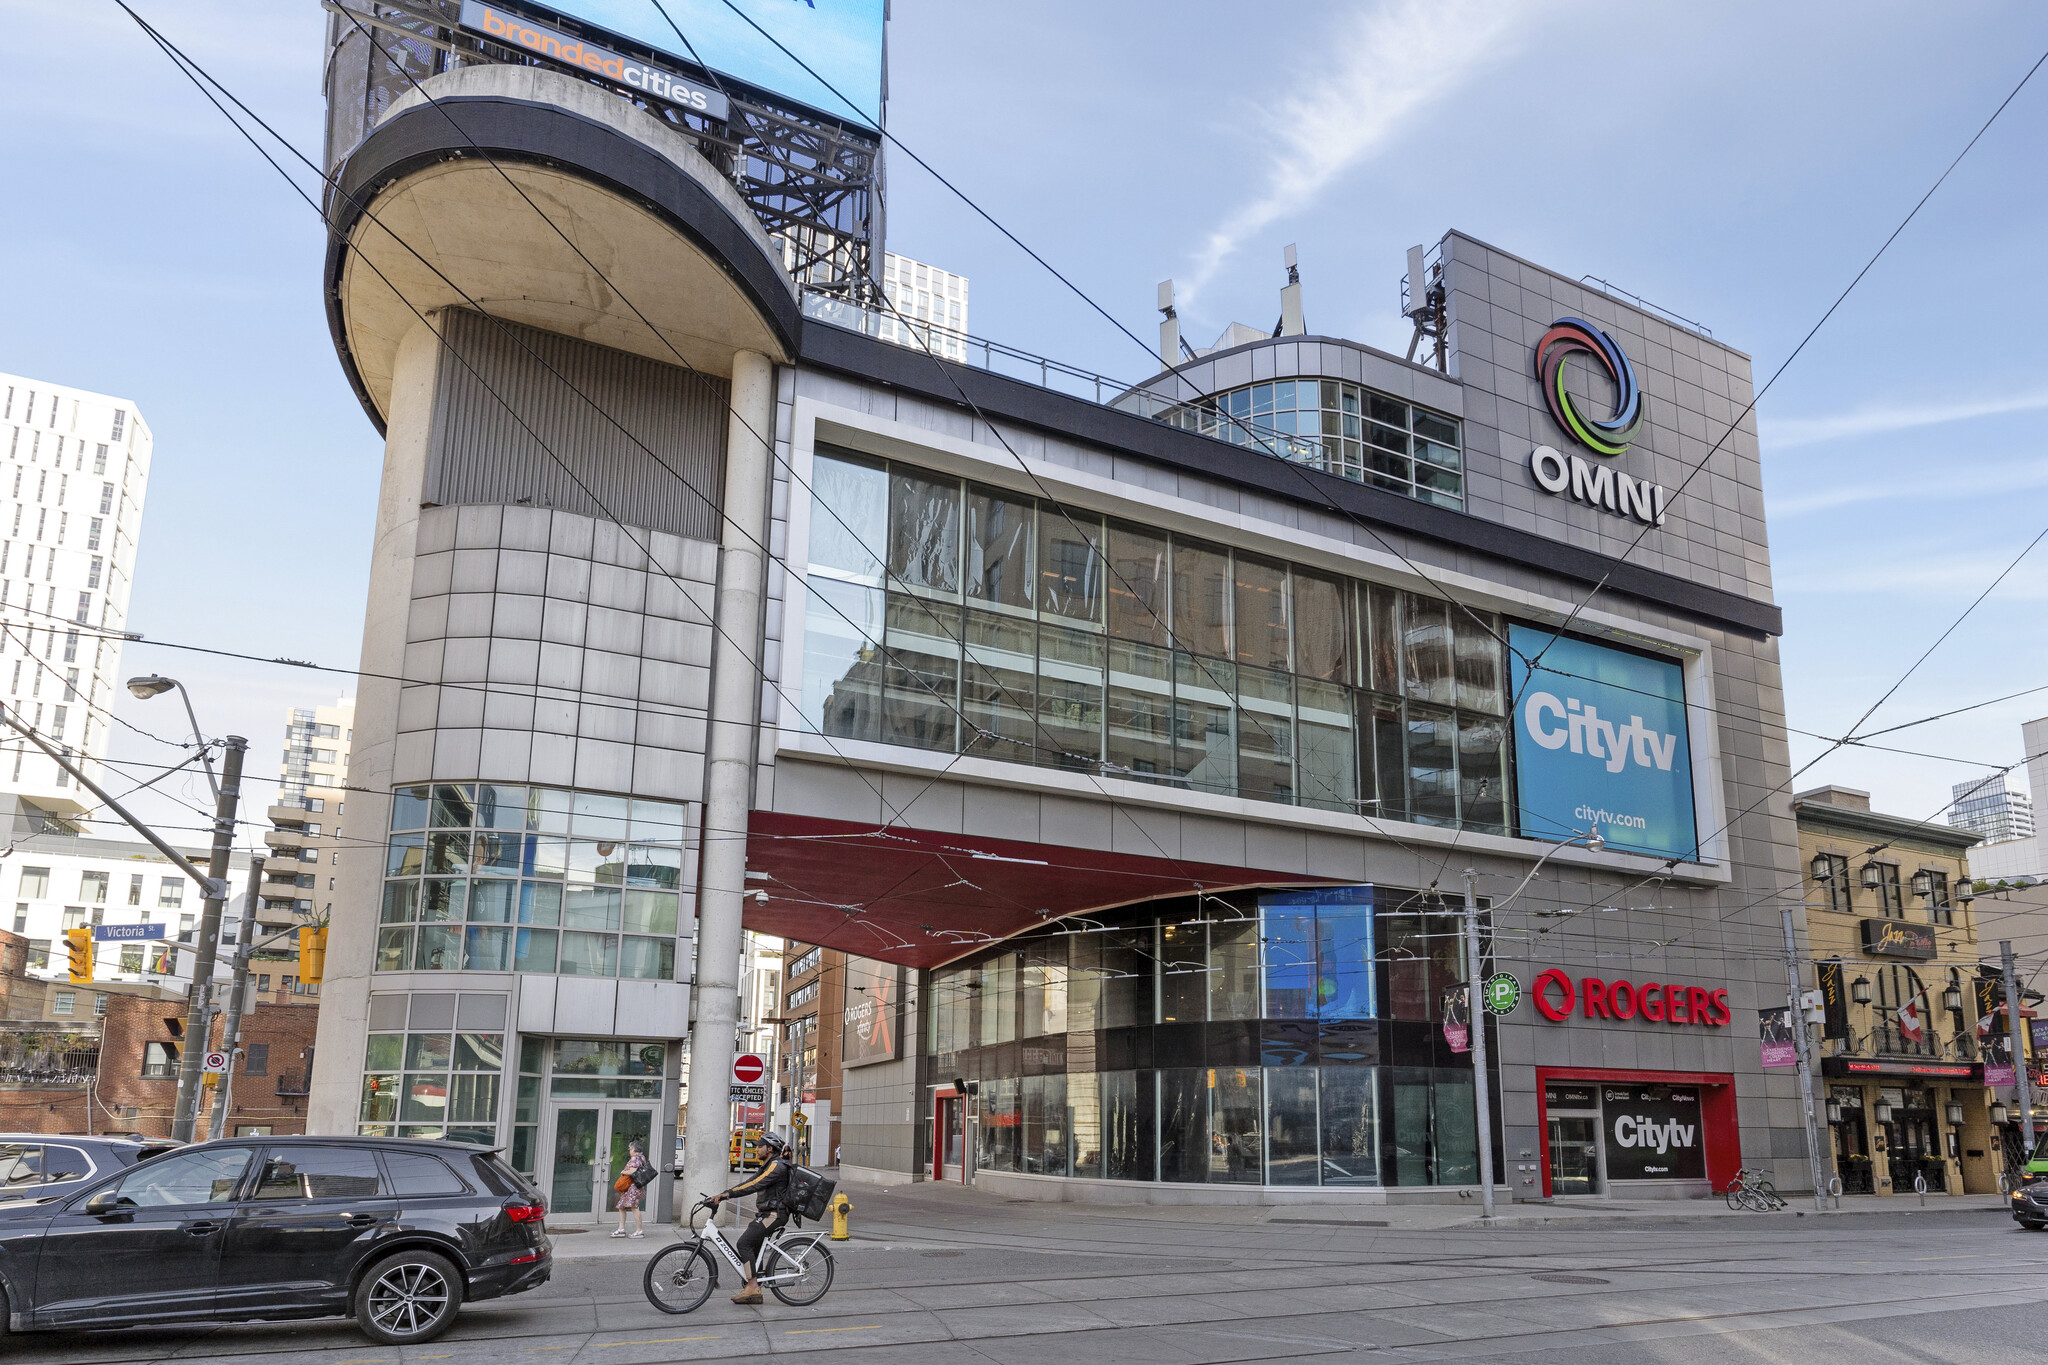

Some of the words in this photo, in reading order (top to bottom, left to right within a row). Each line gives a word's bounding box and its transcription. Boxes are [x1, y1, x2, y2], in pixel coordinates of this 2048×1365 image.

[483, 8, 708, 111] brandedcities
[1529, 445, 1666, 528] OMNI
[1524, 691, 1677, 773] Citytv
[1574, 804, 1646, 829] citytv.com
[107, 926, 145, 937] Victoria
[1495, 983, 1510, 1001] P
[1582, 977, 1731, 1027] ROGERS
[850, 1000, 872, 1022] ROGERS
[1614, 1115, 1695, 1155] Citytv
[720, 1241, 742, 1267] zoomo
